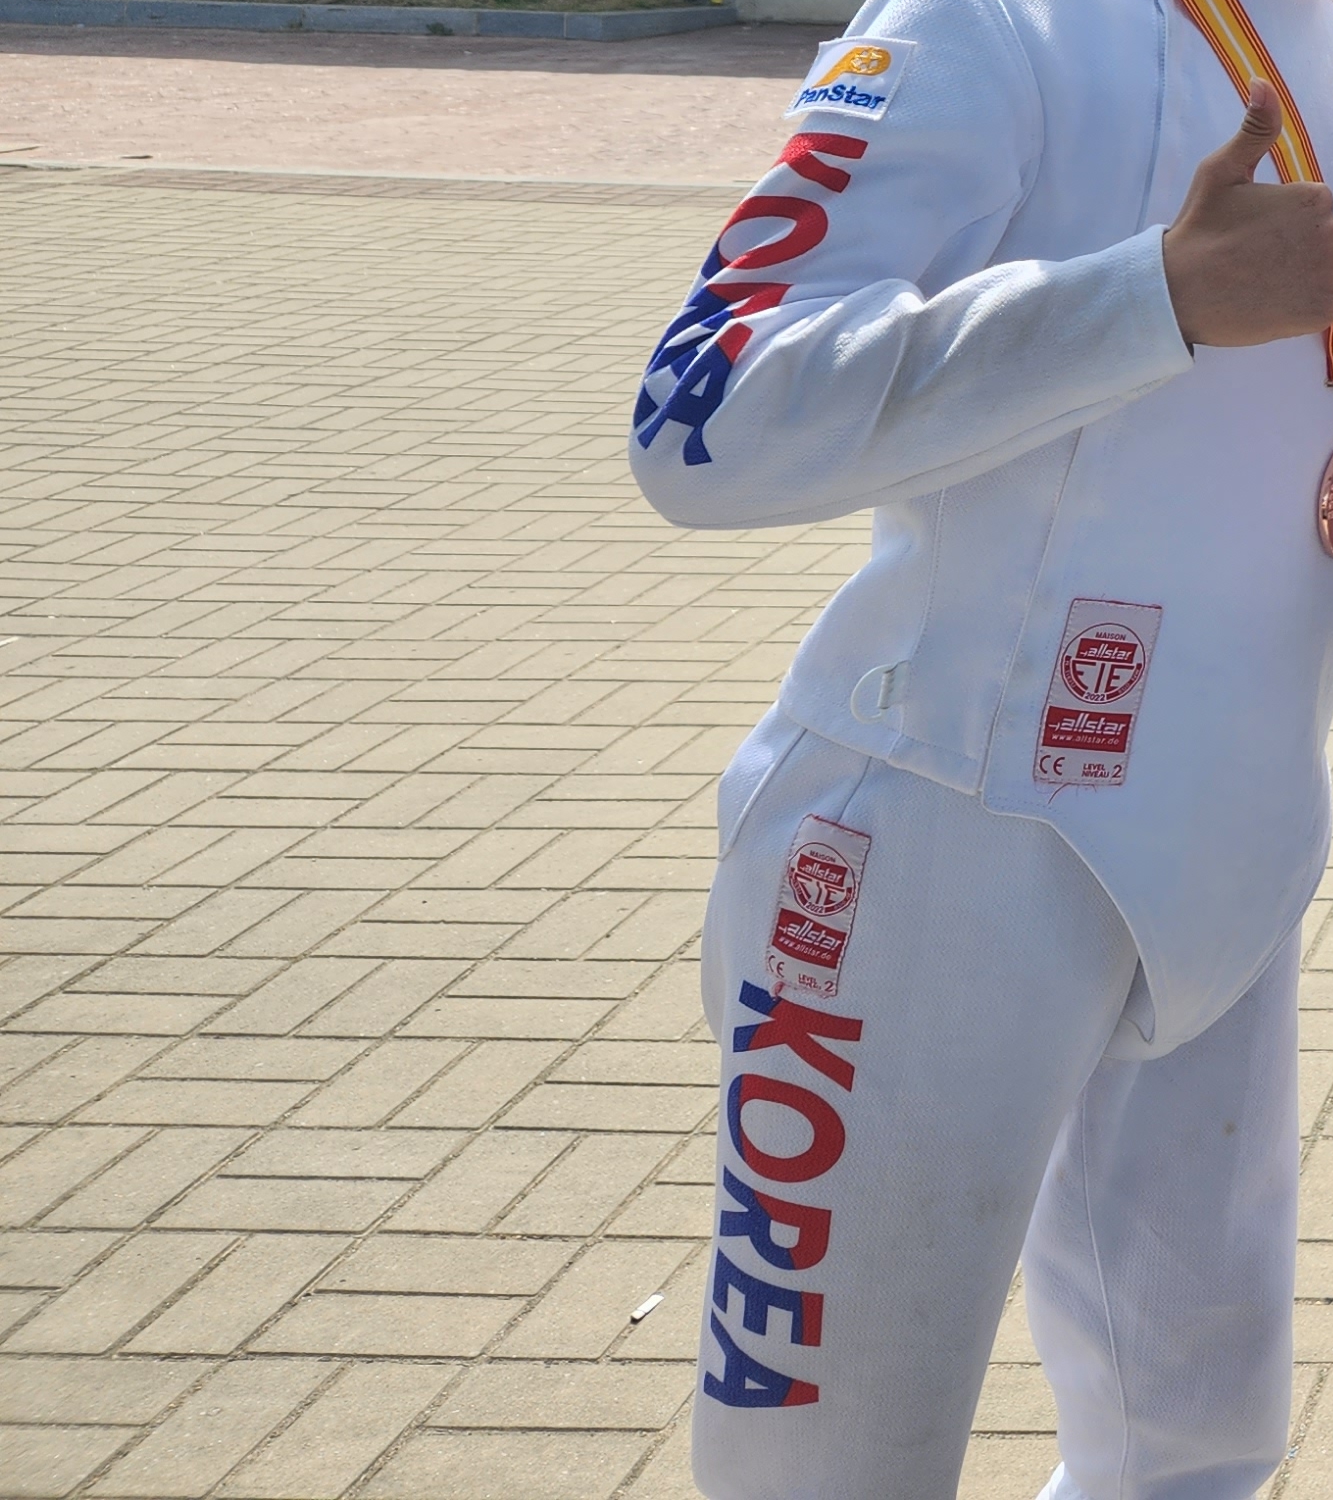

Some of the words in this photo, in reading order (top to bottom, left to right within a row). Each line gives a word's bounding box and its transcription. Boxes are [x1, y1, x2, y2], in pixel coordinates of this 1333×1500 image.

[795, 85, 886, 110] PanStar
[1095, 631, 1127, 641] MAISON
[1087, 643, 1132, 661] allstar
[1085, 691, 1106, 701] 2022
[1060, 713, 1126, 736] allstar
[1051, 733, 1120, 746] www.allstar.de
[1039, 755, 1066, 776] CE
[1083, 763, 1106, 772] LEVEL
[1112, 764, 1123, 779] 2
[809, 850, 836, 863] MAISON
[804, 863, 842, 885] allstar
[805, 901, 824, 914] 2022
[786, 920, 842, 950] allstar
[704, 980, 864, 1409] KOREA
